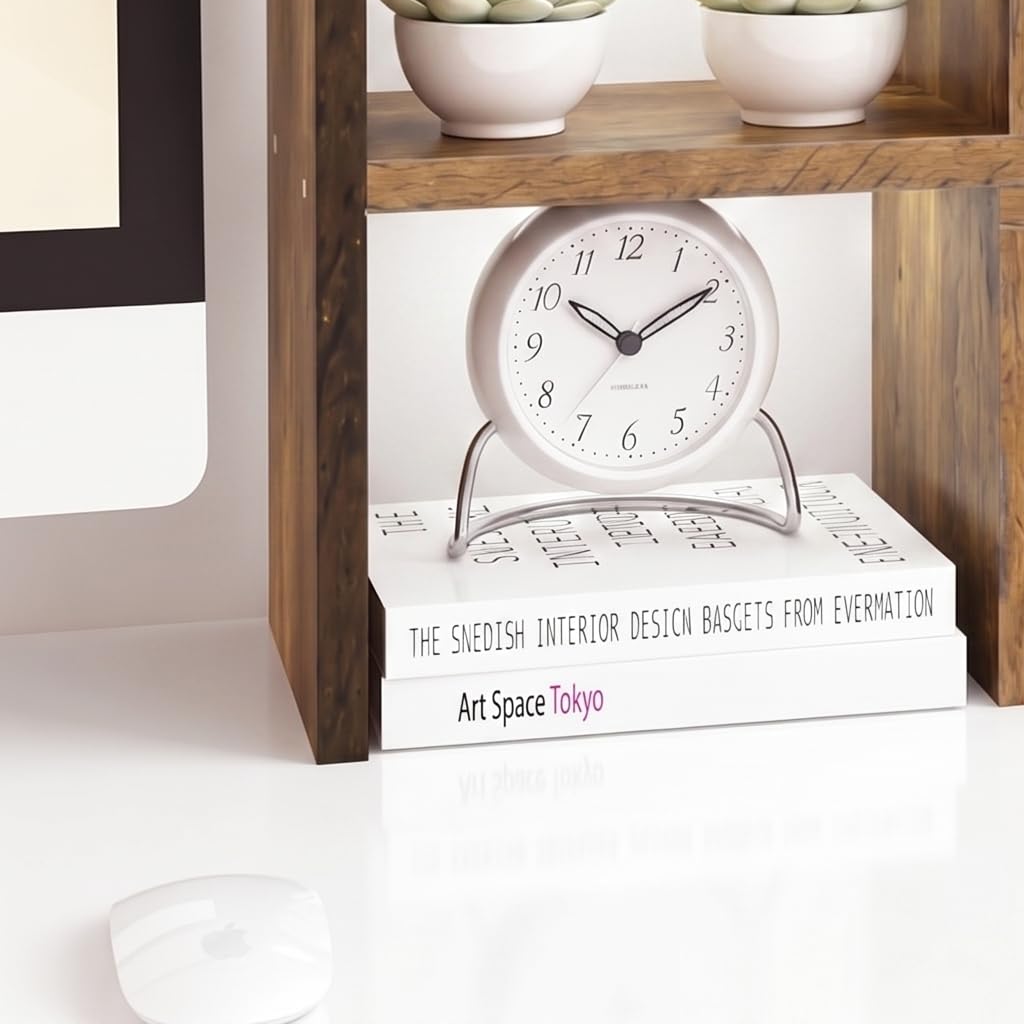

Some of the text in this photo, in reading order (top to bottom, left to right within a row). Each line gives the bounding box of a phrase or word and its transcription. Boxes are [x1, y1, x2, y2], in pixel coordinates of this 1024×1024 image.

[614, 234, 644, 261] 12
[671, 247, 684, 273] 1
[572, 250, 595, 276] 11
[532, 282, 562, 311] 10
[703, 278, 720, 304] 2
[524, 332, 543, 363] 9
[719, 326, 735, 352] 3
[537, 380, 554, 408] 8
[705, 374, 723, 401] 4
[576, 414, 592, 442] 7
[621, 419, 639, 451] 6
[670, 408, 687, 435] 5
[409, 626, 441, 658] THE
[451, 619, 525, 654] SNEDISH
[537, 613, 620, 648] INTERIOR
[784, 596, 824, 628] FROM
[834, 587, 934, 625] EVERMATION
[458, 683, 604, 727] Art Space Tokyo
